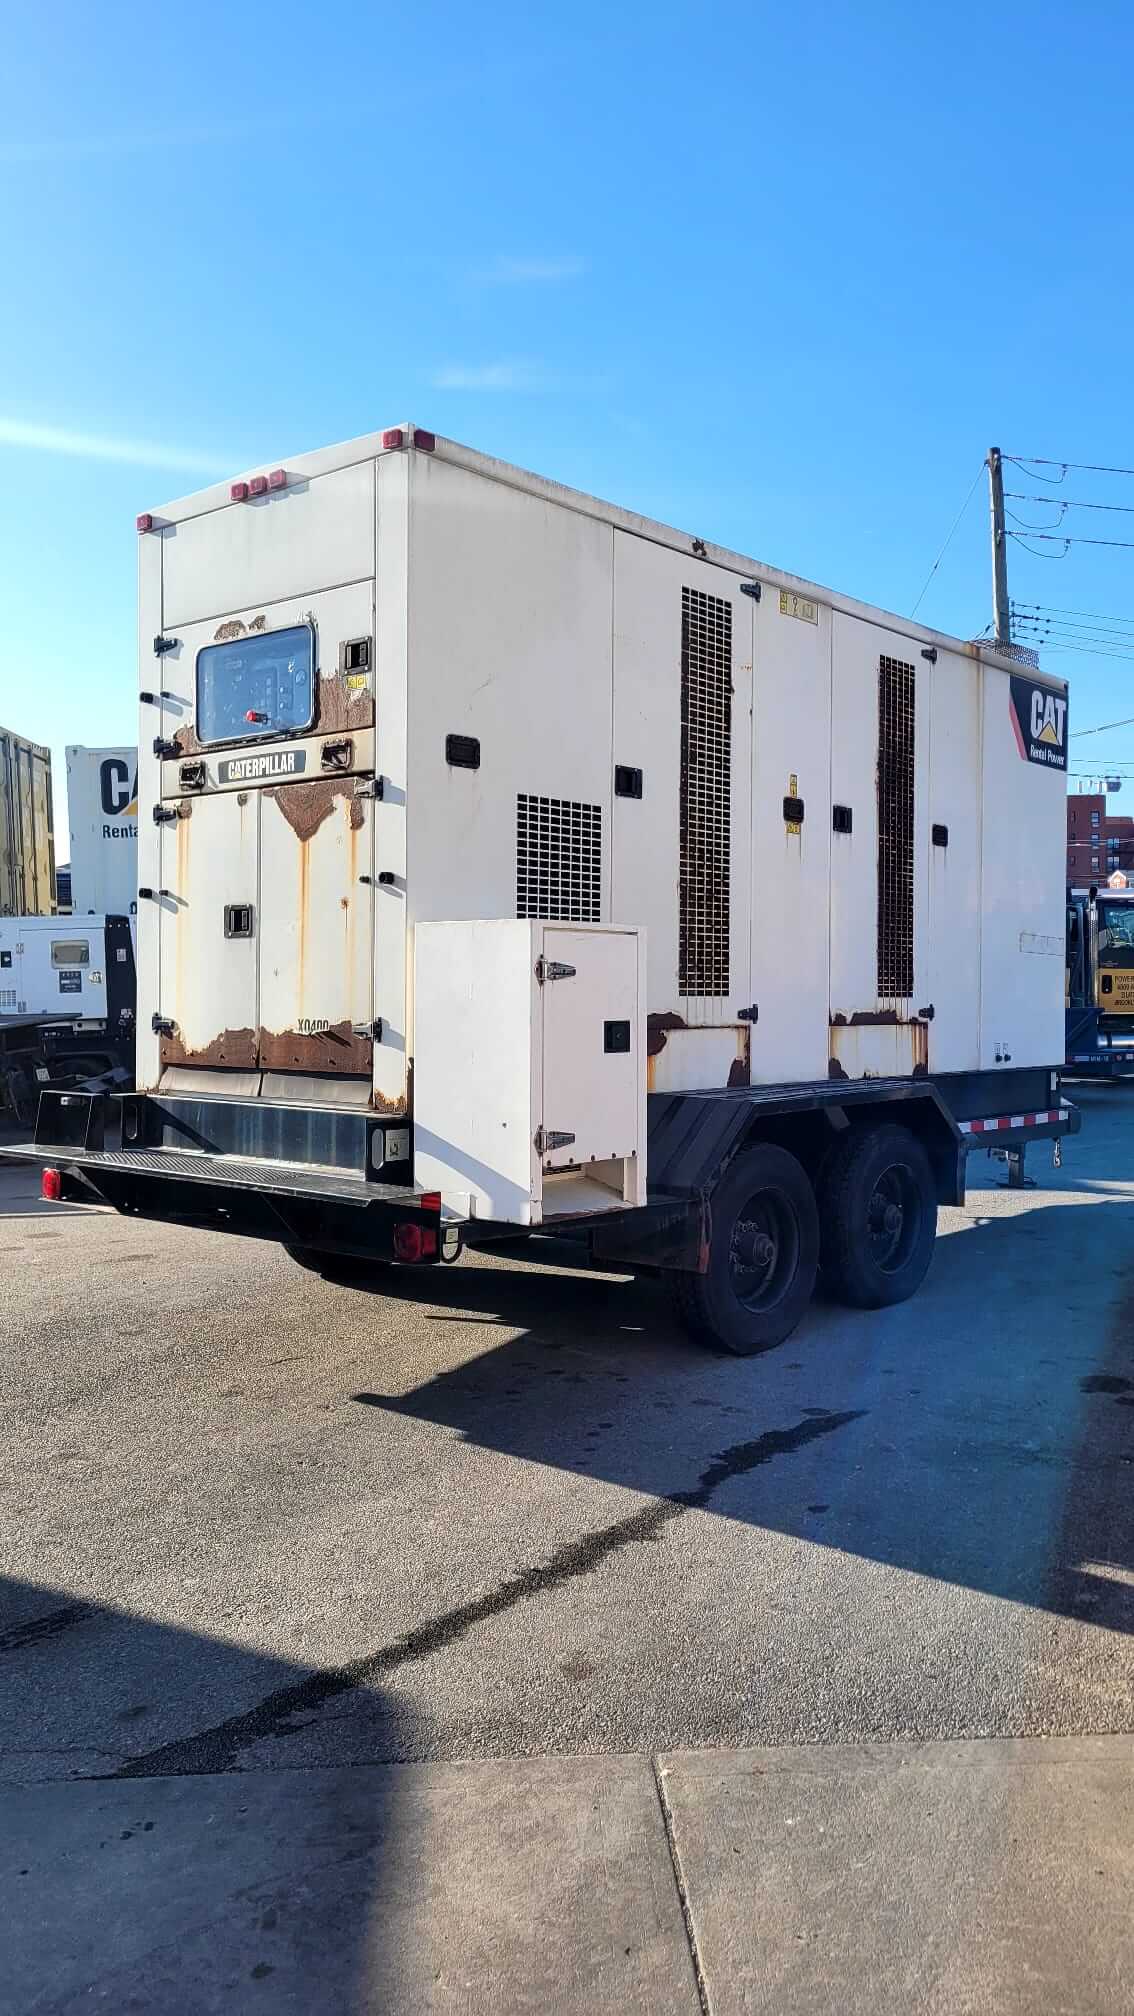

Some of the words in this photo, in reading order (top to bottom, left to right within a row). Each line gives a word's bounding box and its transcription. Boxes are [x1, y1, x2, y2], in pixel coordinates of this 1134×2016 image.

[1030, 689, 1067, 746] CAT
[228, 753, 295, 780] CATERPILLAR
[1030, 744, 1047, 761] Rental
[1048, 749, 1065, 766] Power
[100, 759, 138, 815] C
